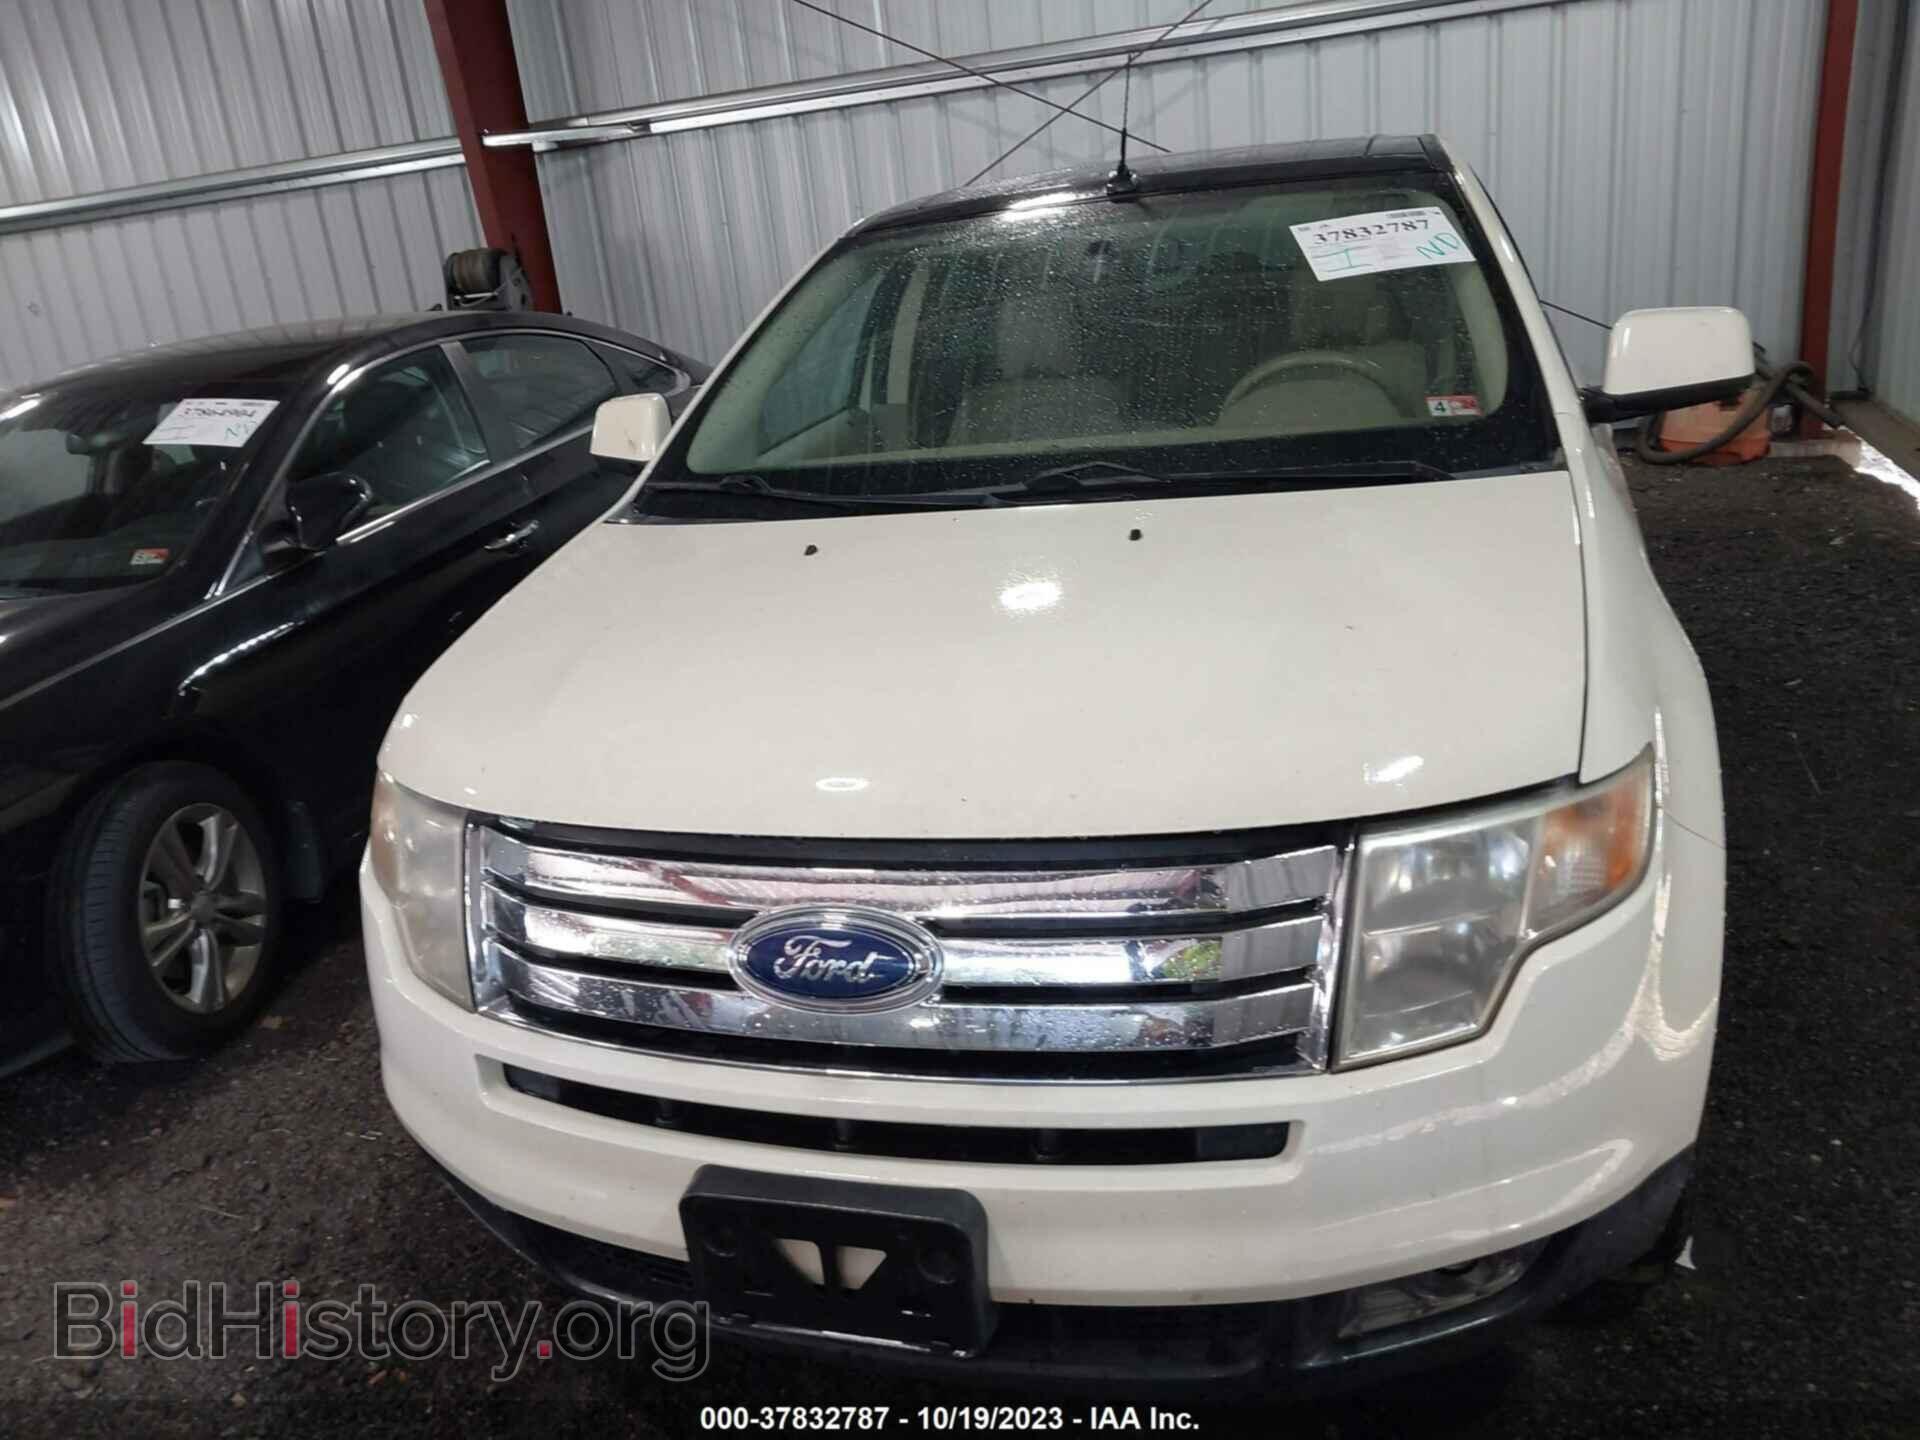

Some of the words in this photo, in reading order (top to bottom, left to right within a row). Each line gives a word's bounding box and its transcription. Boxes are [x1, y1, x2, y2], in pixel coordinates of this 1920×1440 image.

[1313, 219, 1429, 245] 37832787
[1434, 400, 1447, 413] 4
[772, 934, 897, 984] Ford
